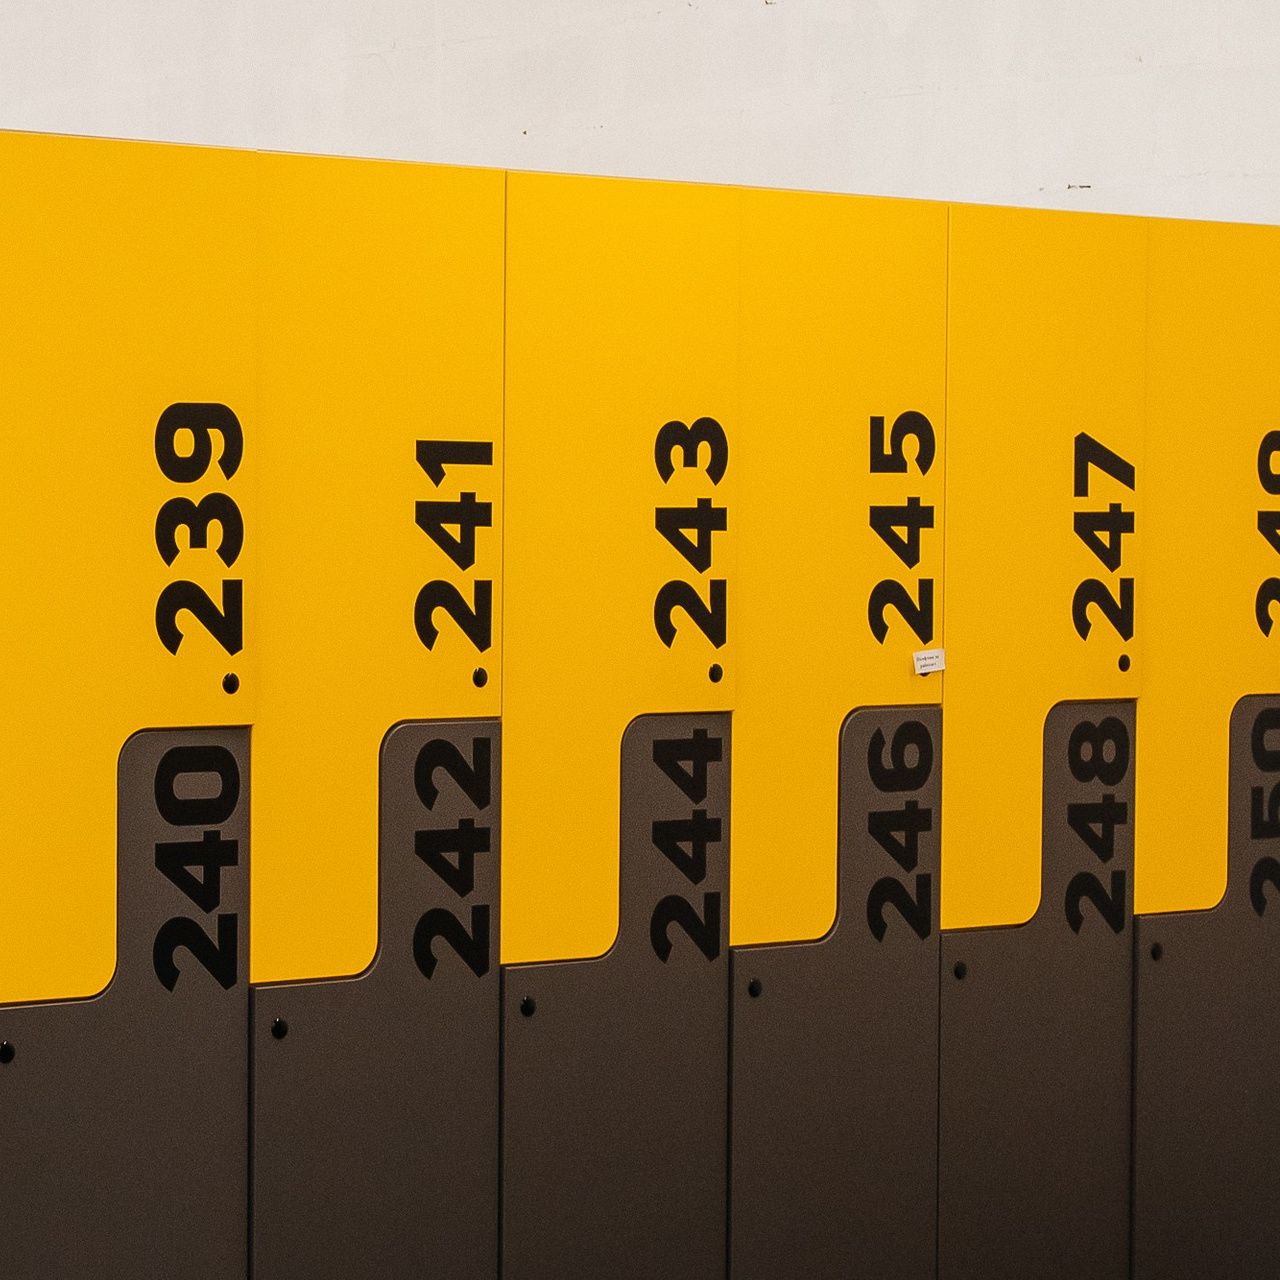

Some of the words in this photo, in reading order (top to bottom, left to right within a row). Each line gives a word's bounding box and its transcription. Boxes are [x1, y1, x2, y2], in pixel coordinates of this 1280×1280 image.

[154, 402, 244, 657] 239
[413, 439, 494, 653] 241
[653, 416, 729, 649] 243
[867, 410, 936, 645] 245
[1071, 431, 1136, 642] 247
[152, 745, 241, 993] 240
[412, 737, 492, 981] 242
[649, 728, 723, 964] 244
[865, 720, 933, 943] 246
[1064, 716, 1130, 935] 248
